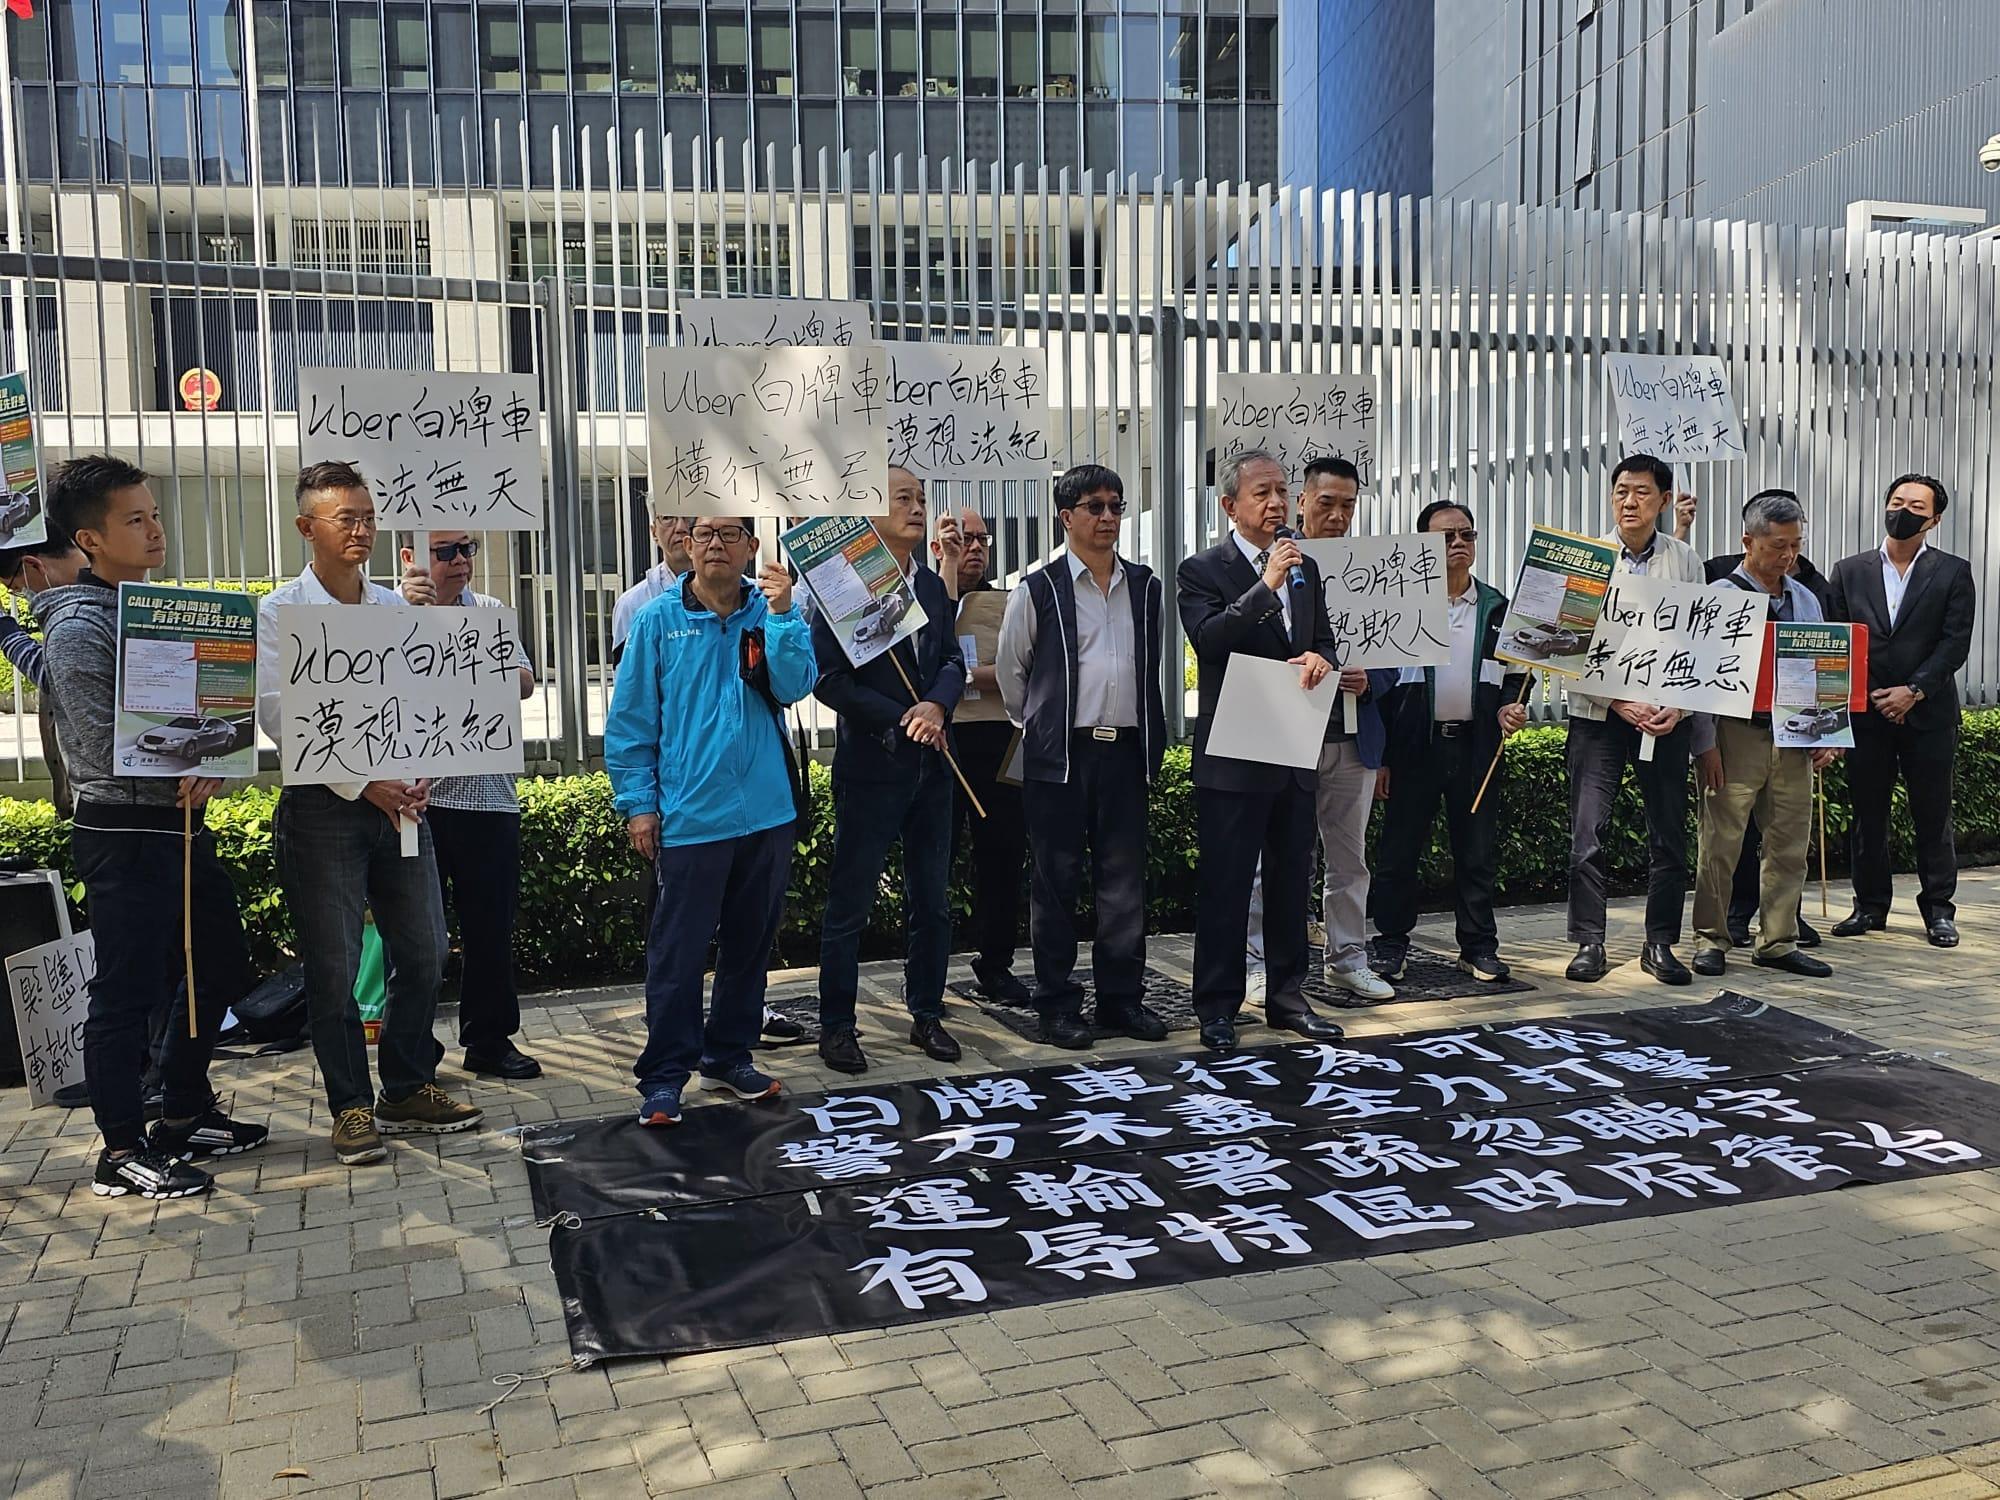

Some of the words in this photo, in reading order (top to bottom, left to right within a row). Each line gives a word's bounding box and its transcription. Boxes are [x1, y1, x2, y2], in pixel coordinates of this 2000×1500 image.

[886, 355, 1041, 411] ber白牌車
[887, 413, 1048, 471] 漠視法紀
[1627, 413, 1743, 457] 無法無天
[348, 459, 537, 519] 法無天
[1321, 542, 1441, 598] r白牌車
[667, 628, 703, 640] KELME
[1326, 607, 1451, 667] 勢欺人
[294, 696, 513, 777] 漠視法紀
